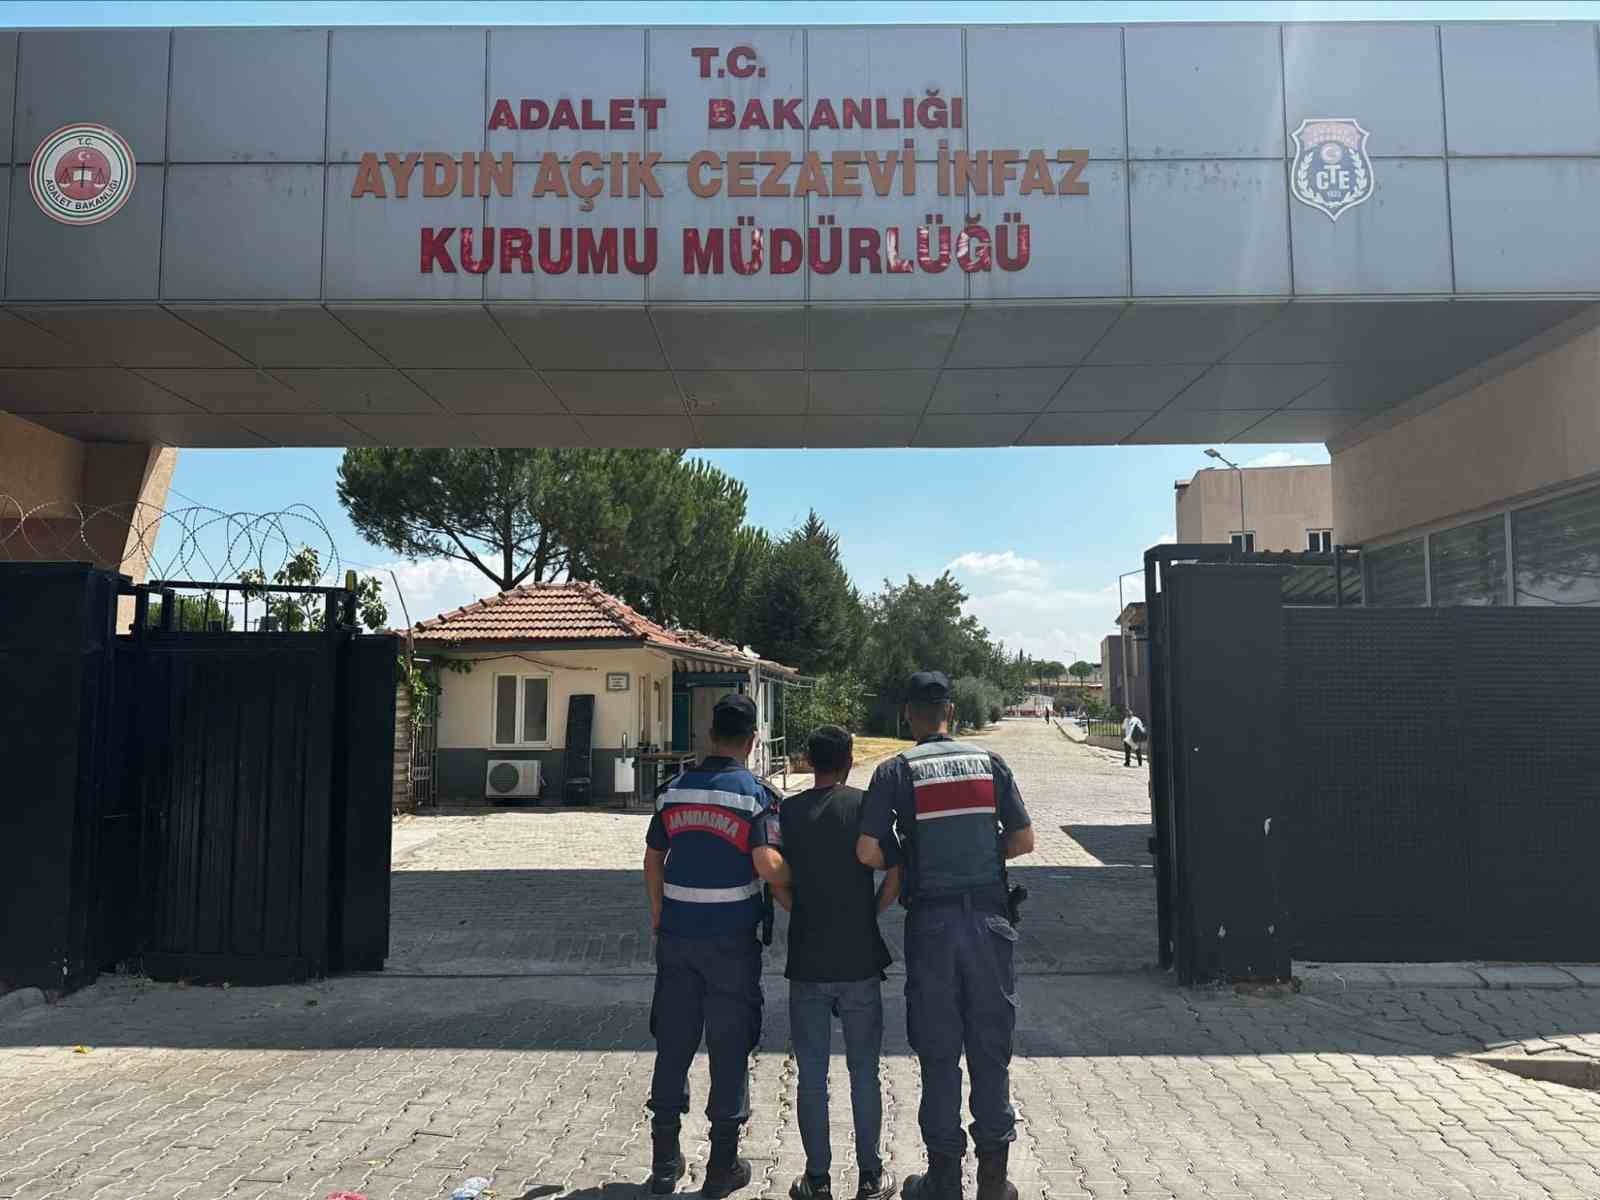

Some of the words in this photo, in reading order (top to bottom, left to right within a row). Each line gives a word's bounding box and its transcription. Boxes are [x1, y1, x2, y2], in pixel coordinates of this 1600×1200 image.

[691, 46, 766, 78] T.C.
[488, 98, 667, 130] ADALET
[708, 88, 963, 130] BAKANLIĞI
[45, 179, 73, 208] ADALET
[351, 151, 514, 199] AYDIN
[531, 150, 664, 212] AÇIK
[687, 138, 917, 198] CEZAEVİ
[937, 139, 1090, 196] İNFAZ
[420, 227, 659, 275] KURUMU
[682, 212, 1031, 276] MÜDÜRLÜĞÜ
